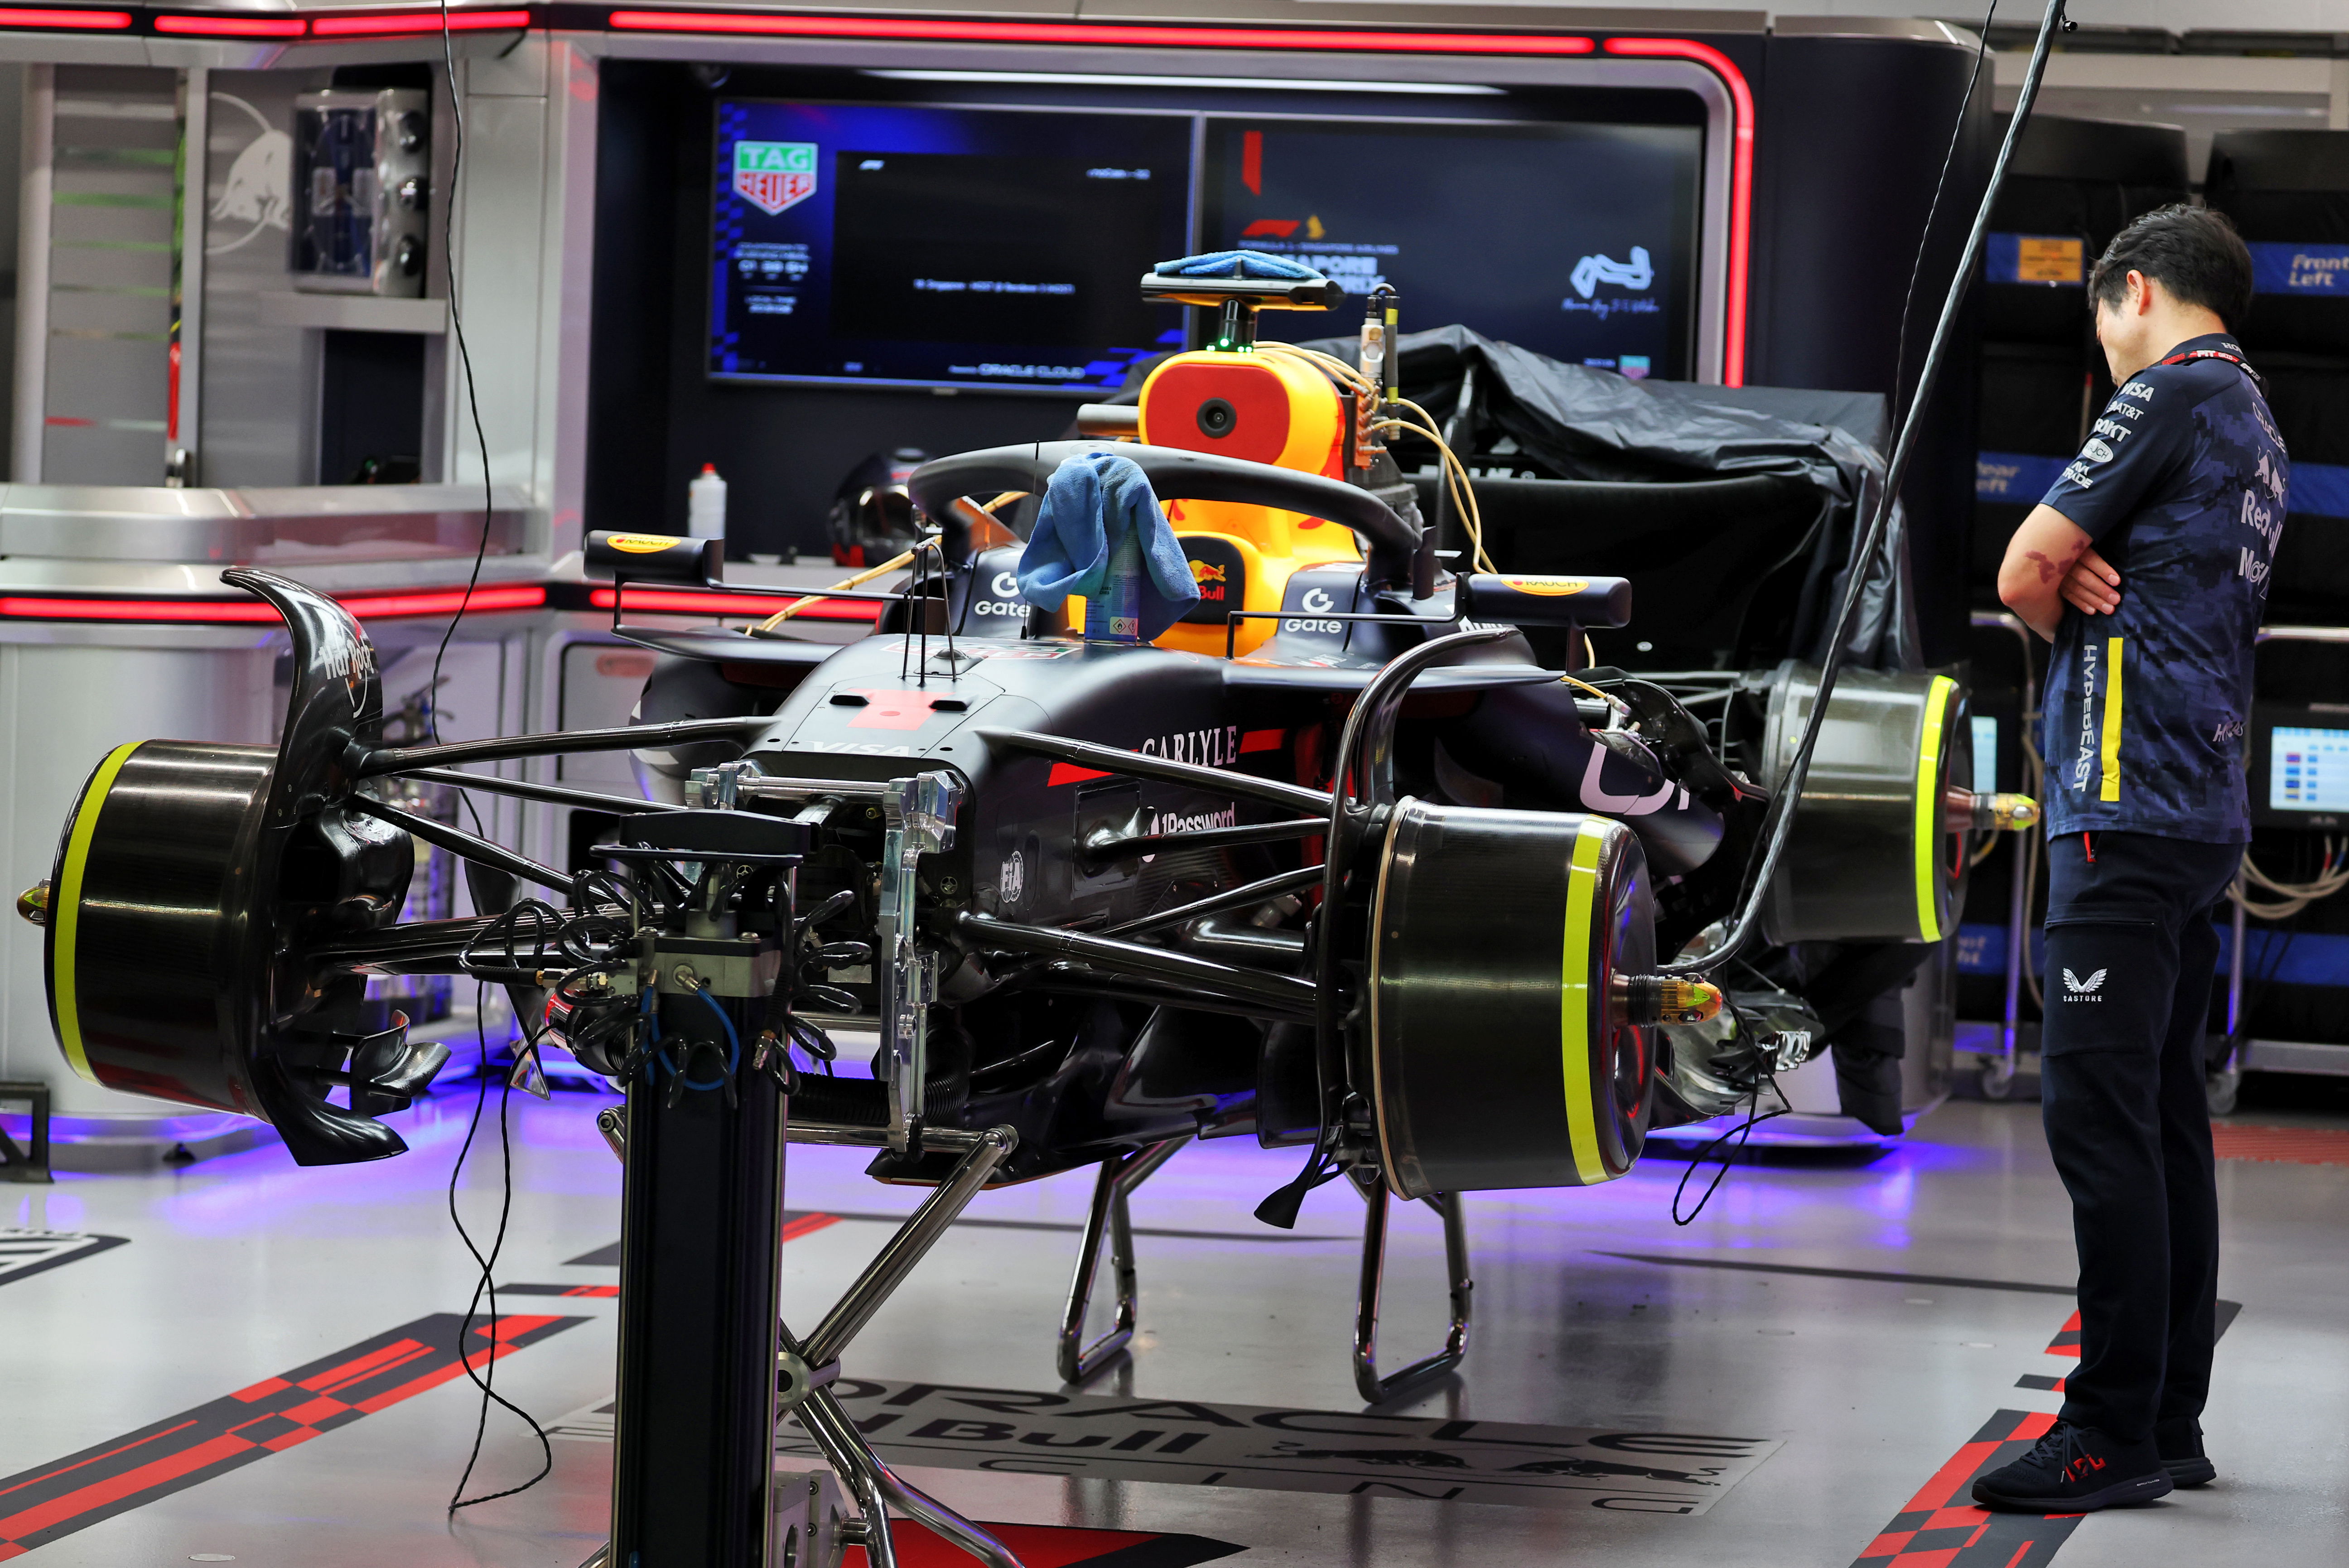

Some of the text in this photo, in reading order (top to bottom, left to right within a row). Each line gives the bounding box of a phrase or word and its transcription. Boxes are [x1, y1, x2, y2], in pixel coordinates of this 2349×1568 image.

[743, 148, 808, 169] TAG
[739, 173, 812, 208] HEUER
[2289, 272, 2335, 287] Left
[2218, 352, 2233, 360] GRID
[2120, 382, 2155, 402] VISA
[2115, 402, 2144, 420] AT&T
[2093, 418, 2132, 442] ROKT
[2062, 467, 2093, 489] TRADE
[2241, 489, 2271, 537] Red
[1526, 579, 1577, 588] RAUCH
[974, 600, 1031, 618] Gate
[1284, 618, 1342, 634] Gate
[347, 639, 374, 680] Rock
[2073, 645, 2098, 792] HYPEBEAST
[805, 740, 910, 757] VISA
[1142, 725, 1237, 767] CARLYLE
[1162, 801, 1235, 834] 1Password
[907, 1419, 1210, 1453] Bull
